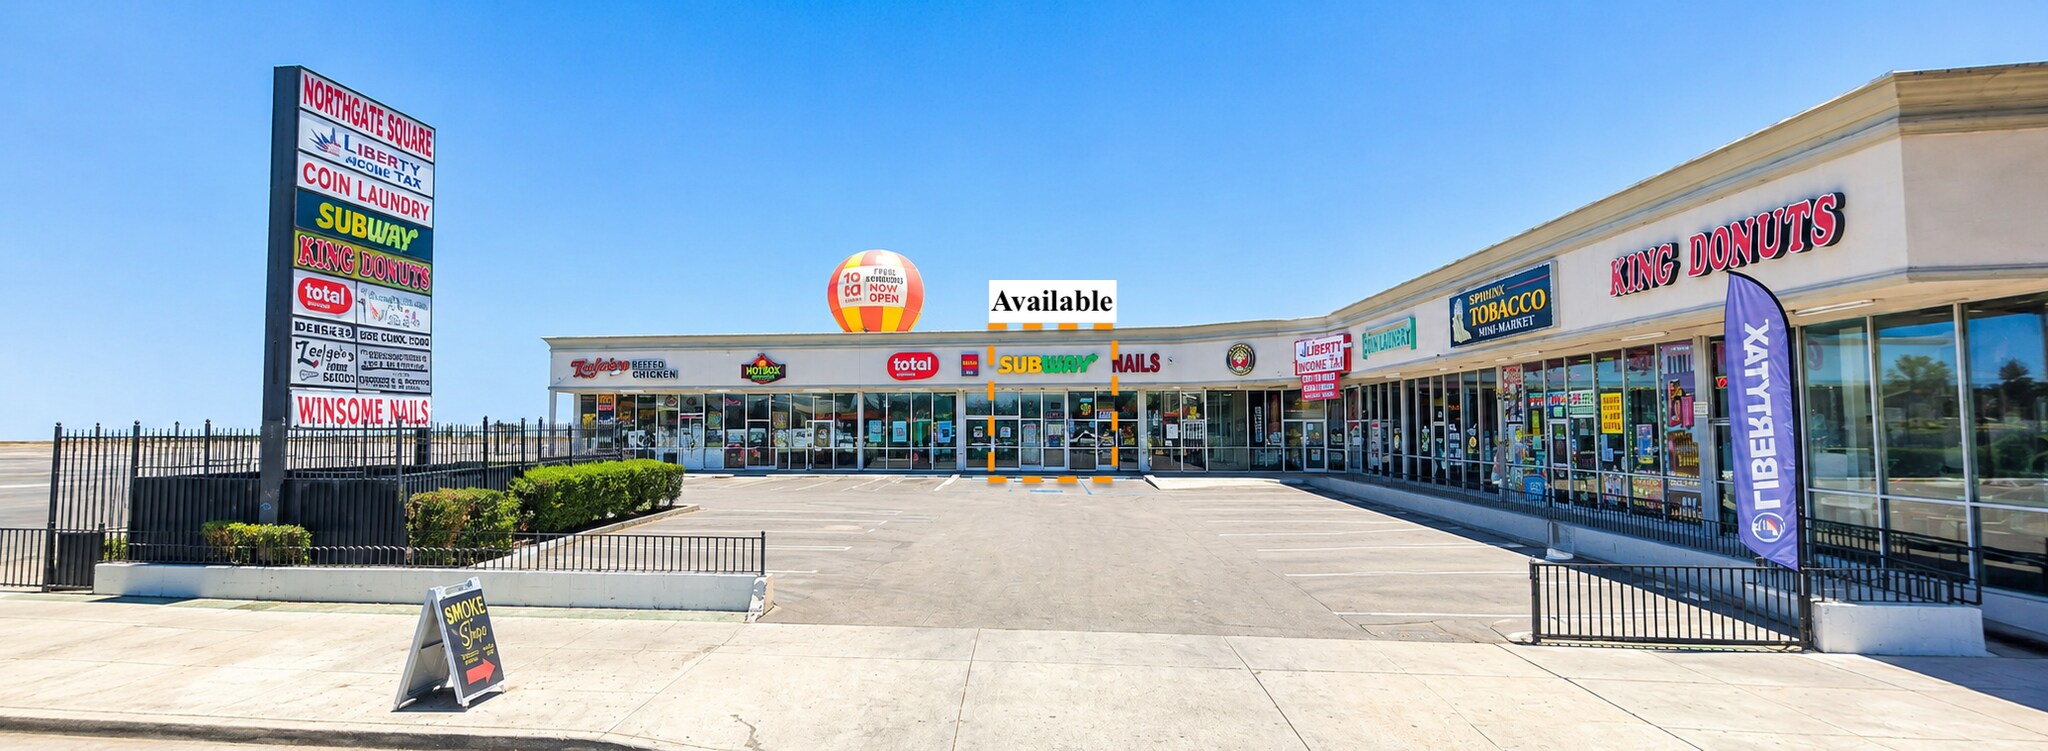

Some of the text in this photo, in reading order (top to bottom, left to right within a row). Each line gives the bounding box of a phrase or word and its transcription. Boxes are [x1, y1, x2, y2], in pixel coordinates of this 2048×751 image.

[303, 74, 433, 158] NORTHGATE SQUARE
[344, 134, 421, 176] LIBERTY
[303, 162, 430, 221] COIN LAUNDRY
[316, 202, 419, 252] SUBWAY
[1609, 192, 1846, 297] KING DONUTS
[298, 233, 431, 291] KING DONUTS
[305, 282, 345, 305] total
[869, 283, 898, 293] NOW
[869, 293, 899, 304] OPEN
[1469, 288, 1547, 327] TOBACCO
[1478, 315, 1536, 337] MINI-MARKET
[1307, 340, 1342, 356] LIBERTY
[632, 370, 676, 379] CHICKEN
[894, 356, 932, 371] total
[998, 353, 1099, 375] SUBWAY
[1112, 353, 1161, 373] NAILS
[298, 396, 430, 427] WINSOME NAILS
[444, 595, 487, 625] SMOKE
